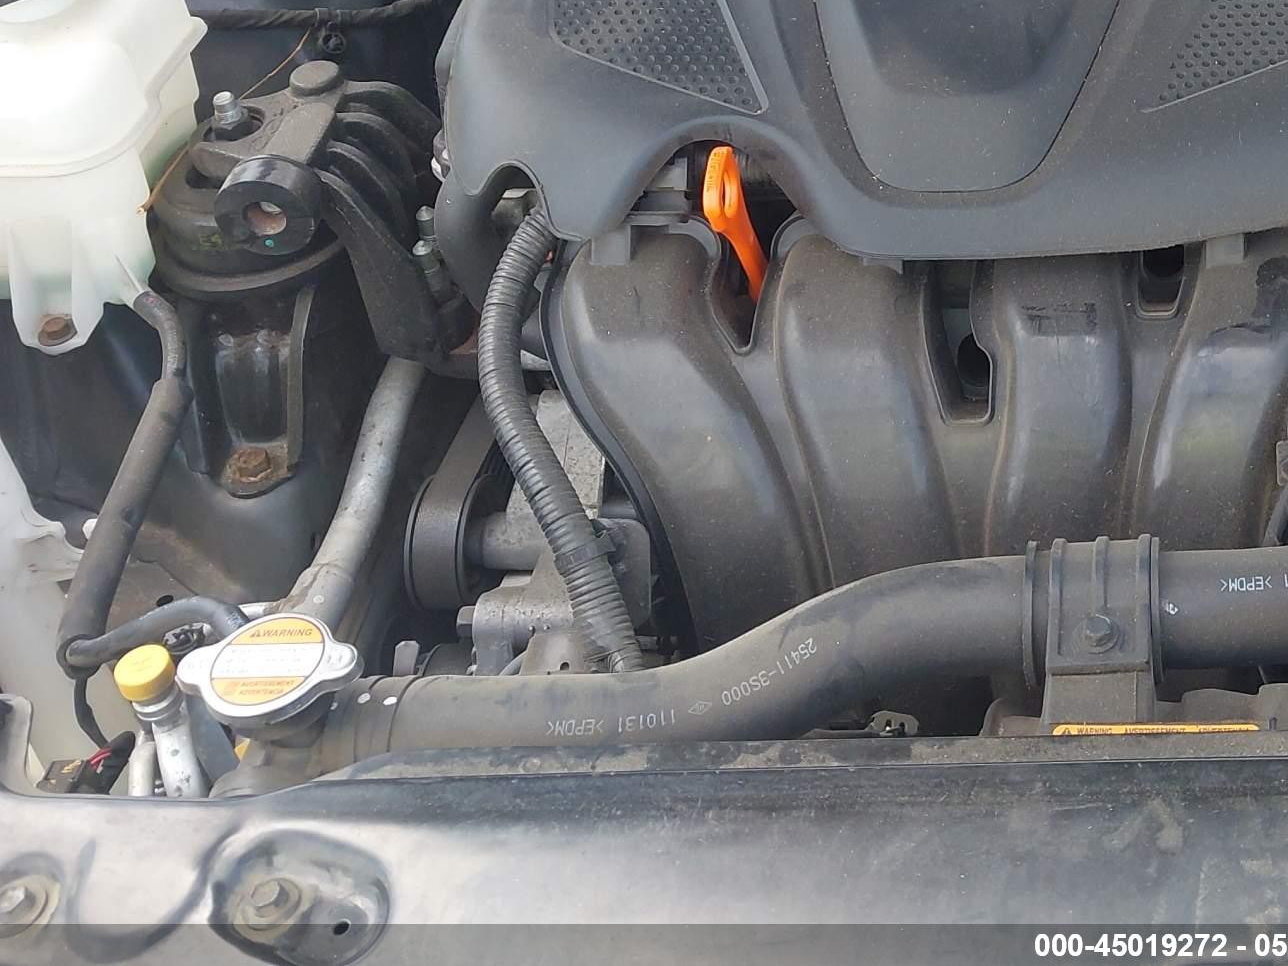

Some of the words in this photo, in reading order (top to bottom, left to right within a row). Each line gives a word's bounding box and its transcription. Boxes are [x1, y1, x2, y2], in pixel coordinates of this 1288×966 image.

[261, 628, 313, 637] WARNING
[721, 637, 818, 706] 25411-3S000
[617, 709, 676, 732] 110131
